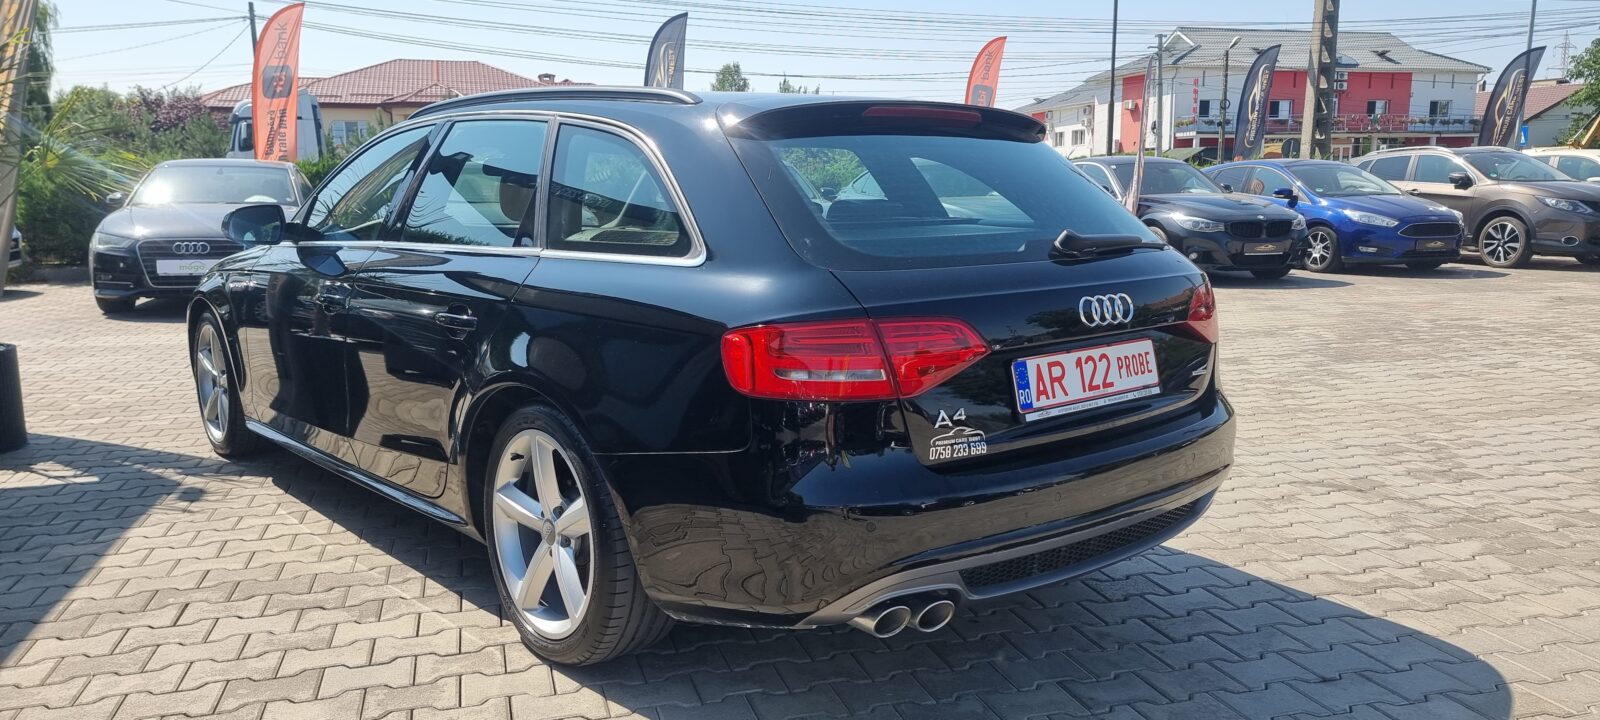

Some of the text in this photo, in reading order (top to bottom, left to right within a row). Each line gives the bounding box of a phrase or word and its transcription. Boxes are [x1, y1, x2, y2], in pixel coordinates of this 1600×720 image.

[274, 22, 288, 59] bank
[981, 49, 995, 80] bank
[278, 131, 287, 153] rate
[1018, 351, 1153, 404] RO AR 122 PROBE
[934, 408, 966, 428] A4
[929, 441, 987, 460] 0758 233 699
